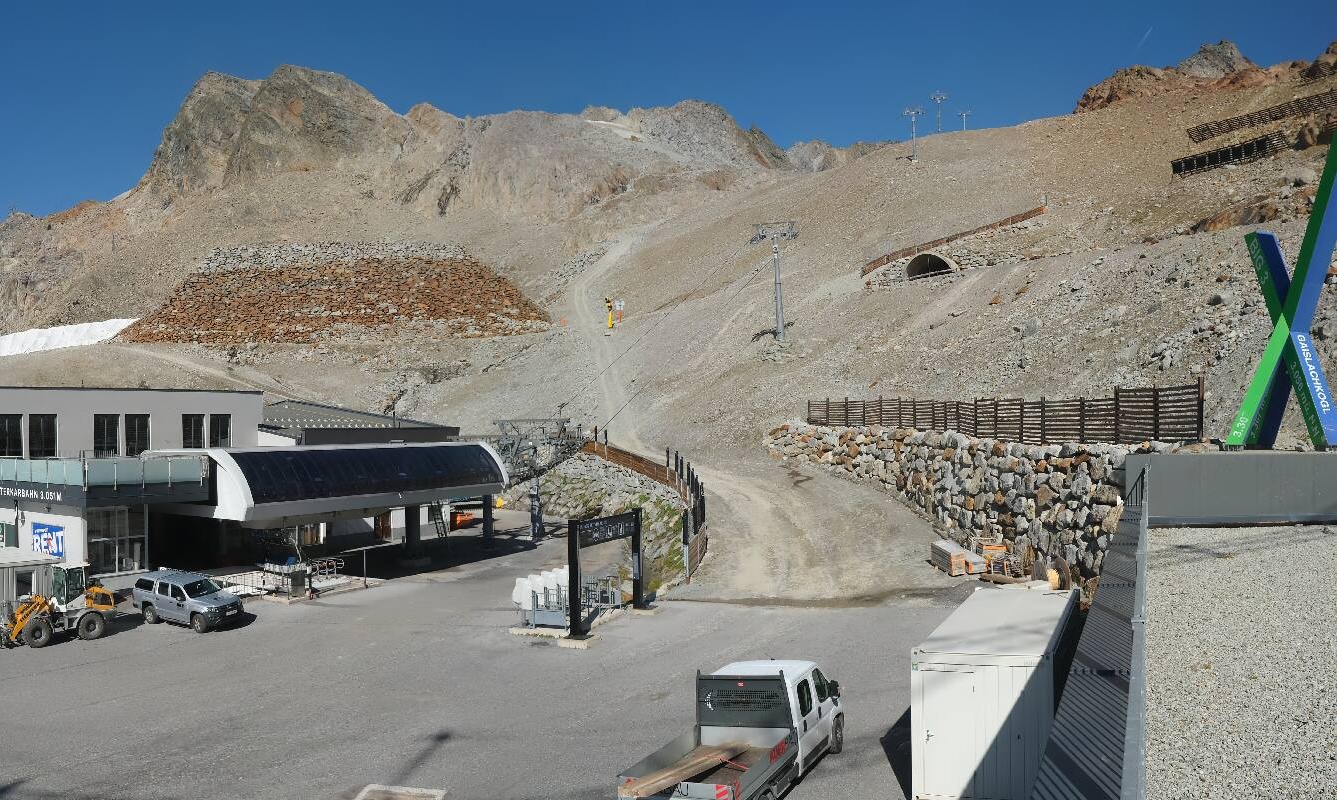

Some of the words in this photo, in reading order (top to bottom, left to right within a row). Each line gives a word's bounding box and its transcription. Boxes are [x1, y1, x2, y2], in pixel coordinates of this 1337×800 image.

[1250, 237, 1264, 271] BIG
[1297, 334, 1331, 415] GAISLACHKOGL
[31, 531, 64, 555] RENT
